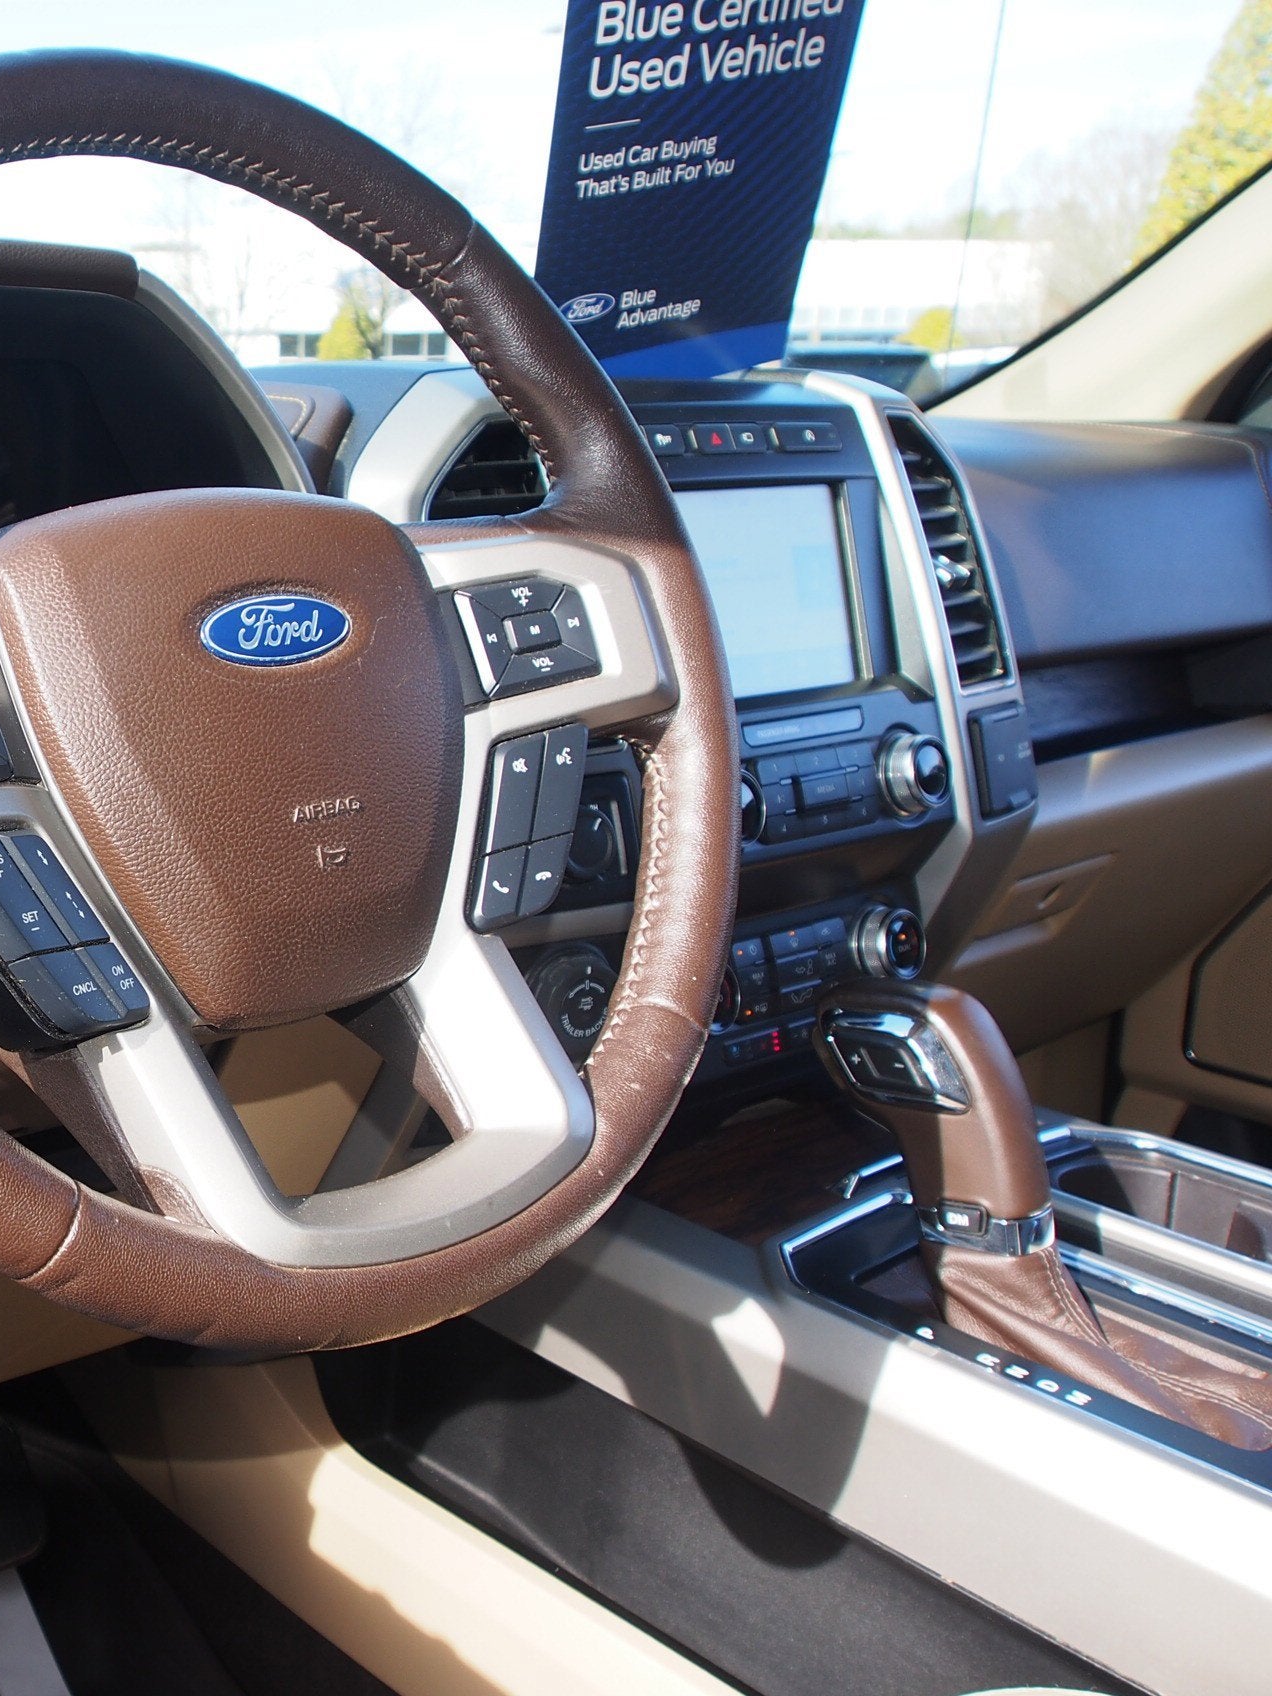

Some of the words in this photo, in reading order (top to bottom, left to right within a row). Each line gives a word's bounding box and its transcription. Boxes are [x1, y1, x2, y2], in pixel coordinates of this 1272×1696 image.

[595, 0, 685, 46] Blue
[589, 42, 692, 99] Used
[701, 27, 826, 83] Vehicle
[580, 146, 626, 173] Used
[628, 145, 659, 165] Car
[661, 135, 718, 160] Buying
[576, 174, 630, 199] That's
[633, 166, 672, 190] Built
[674, 163, 702, 183] For
[706, 158, 736, 177] You
[568, 297, 605, 319] Ford
[620, 288, 657, 309] Blue
[615, 298, 702, 330] Advantage
[511, 586, 533, 598] VOL
[237, 602, 323, 650] Ford
[529, 624, 541, 635] M
[531, 656, 555, 668] VOL
[293, 795, 360, 824] AIRBAG
[21, 910, 39, 924] SET
[111, 964, 125, 977] ON
[72, 980, 98, 997] CNCL
[120, 977, 135, 991] OFF
[560, 1013, 585, 1038] TRAILER
